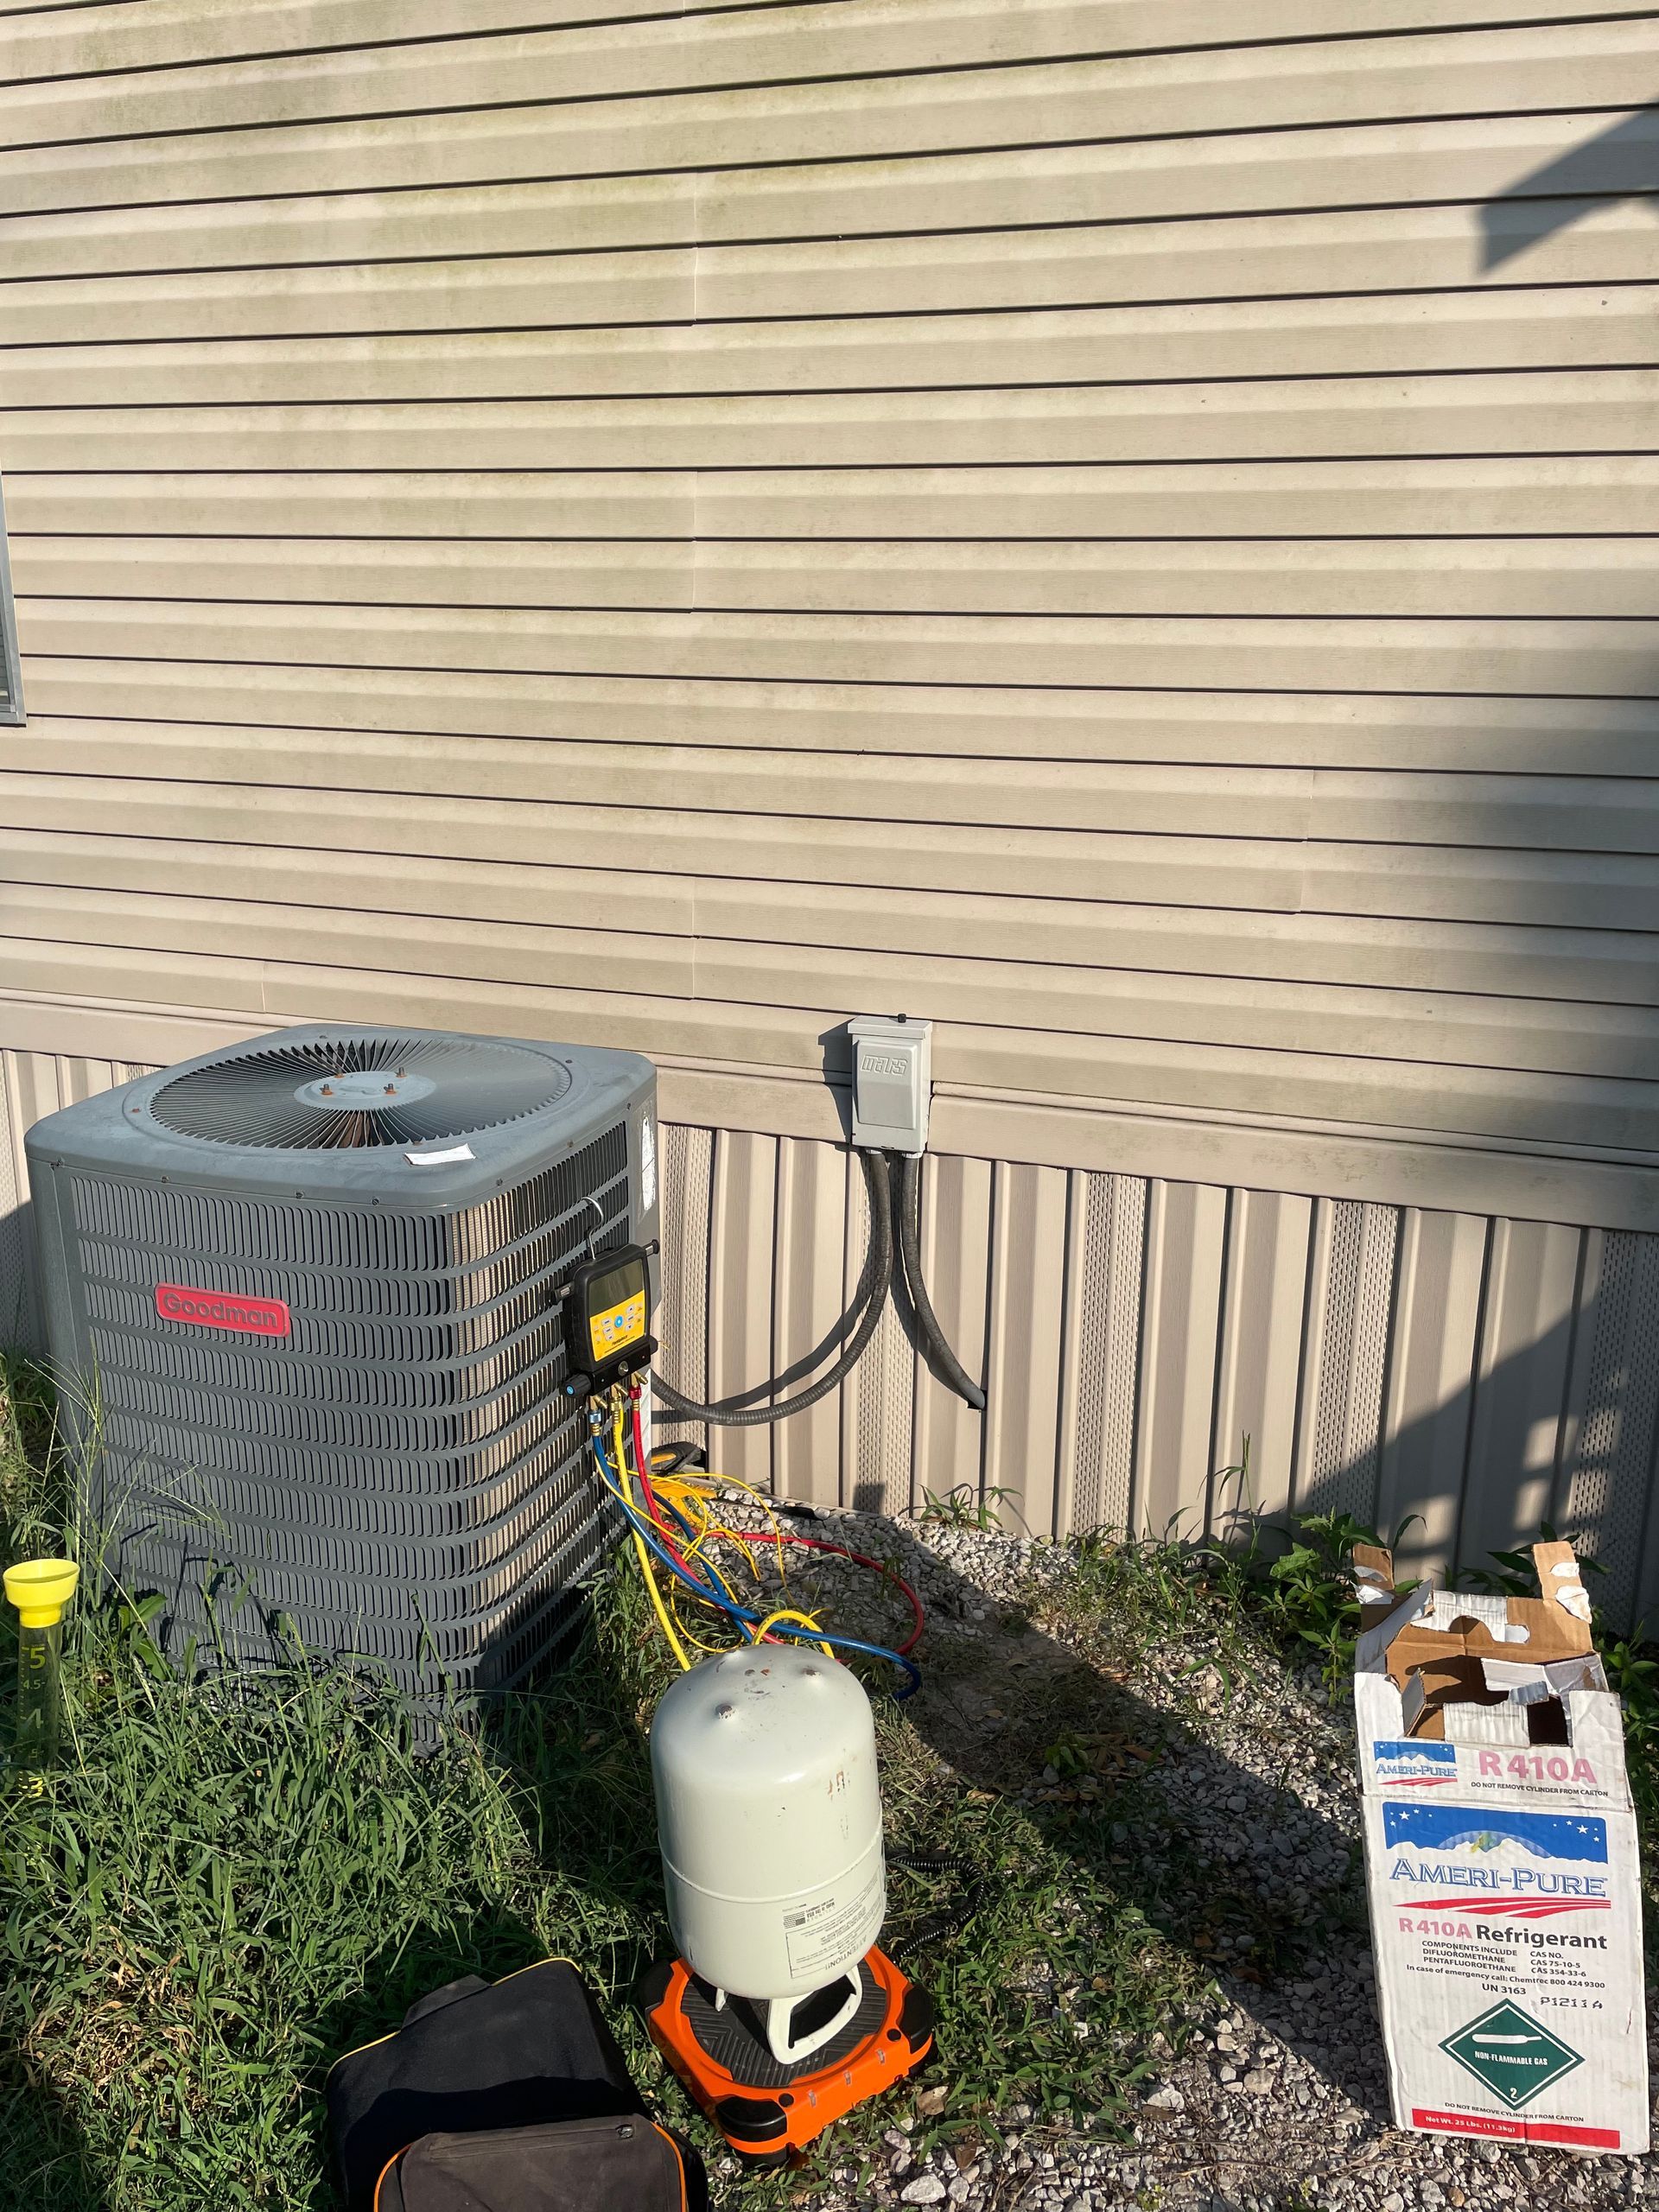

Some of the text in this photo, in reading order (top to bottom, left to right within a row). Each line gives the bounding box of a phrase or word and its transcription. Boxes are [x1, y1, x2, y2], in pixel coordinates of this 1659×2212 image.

[163, 1293, 278, 1328] Goodman
[29, 1646, 46, 1669] 5
[1526, 1785, 1559, 1794] CYLINDER
[1389, 1858, 1607, 1897] AMERI-PURE
[1476, 1924, 1607, 1949] Refrigerant
[1421, 1941, 1517, 1956] COMPONENTS INCLUDE
[1422, 1948, 1505, 1963] DIFLUOROMETHANE
[1423, 1956, 1516, 1973] PENTAFLUOROETHANE
[1548, 1960, 1580, 1968] 75-10-5
[1445, 1969, 1490, 1980] emergency
[1510, 1976, 1549, 1985] Chemtrec
[1549, 1968, 1586, 1977] 354-33-6
[1482, 1983, 1527, 1995] UN 3163
[1474, 2050, 1532, 2065] NON-FLAMMABLE
[1510, 2088, 1517, 2099] 2
[1471, 2106, 1499, 2115] REMOVE
